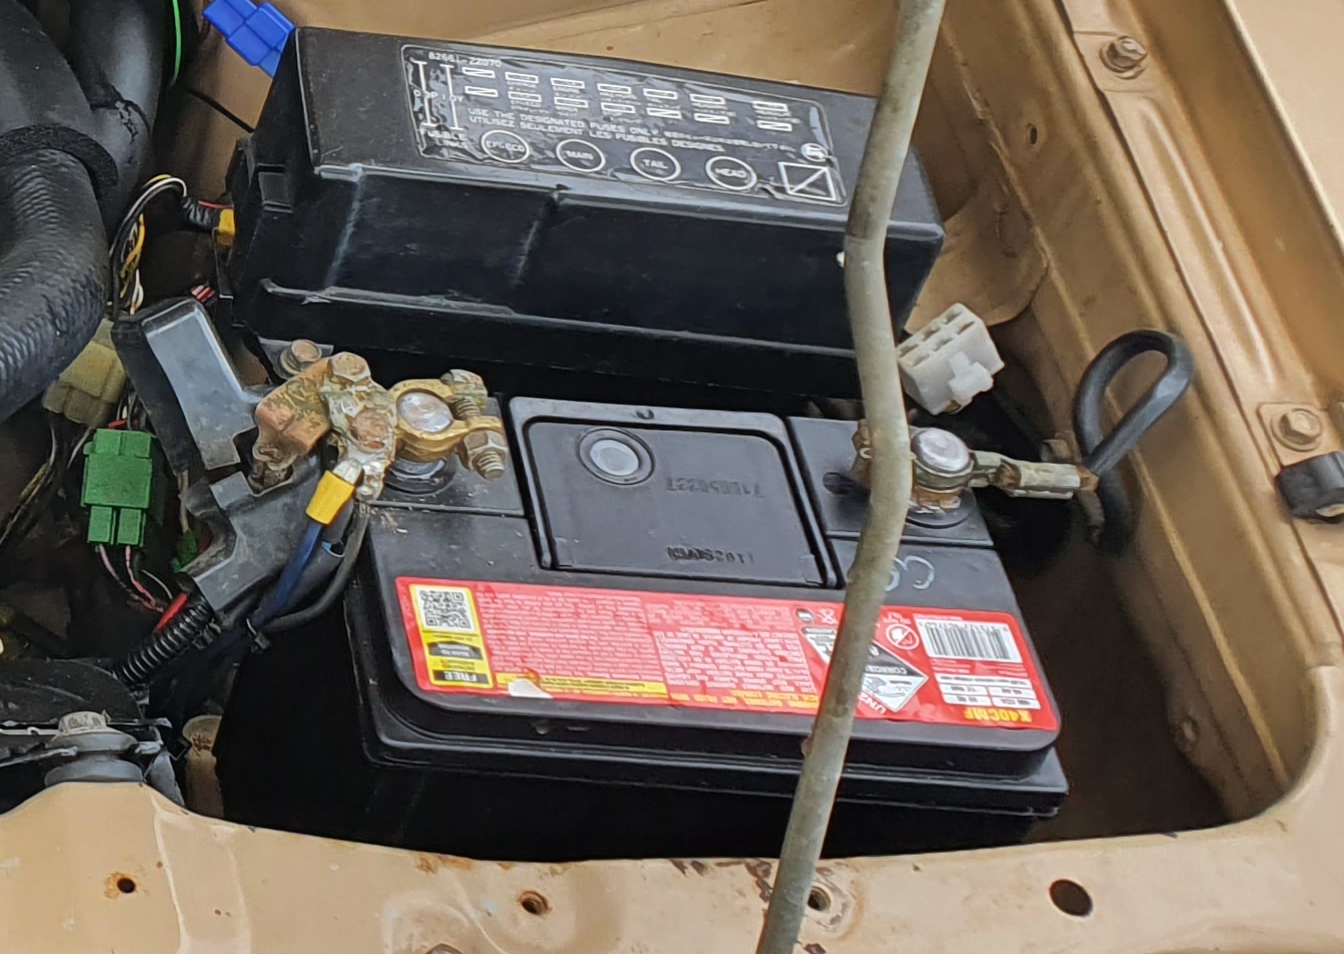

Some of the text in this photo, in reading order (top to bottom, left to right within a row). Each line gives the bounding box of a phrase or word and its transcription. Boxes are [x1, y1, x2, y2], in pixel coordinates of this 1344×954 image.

[468, 107, 489, 116] USE
[493, 110, 515, 120] THE
[519, 114, 586, 129] DESIGNATED
[590, 122, 627, 134] FUSES
[469, 114, 516, 128] UTILISEZ
[519, 121, 585, 136] SEULEMENT
[616, 132, 669, 146] FUSIBLES
[565, 149, 595, 161] MAIN
[642, 158, 670, 170] TAIL
[714, 166, 748, 179] HEAD
[443, 670, 478, 682] FREE
